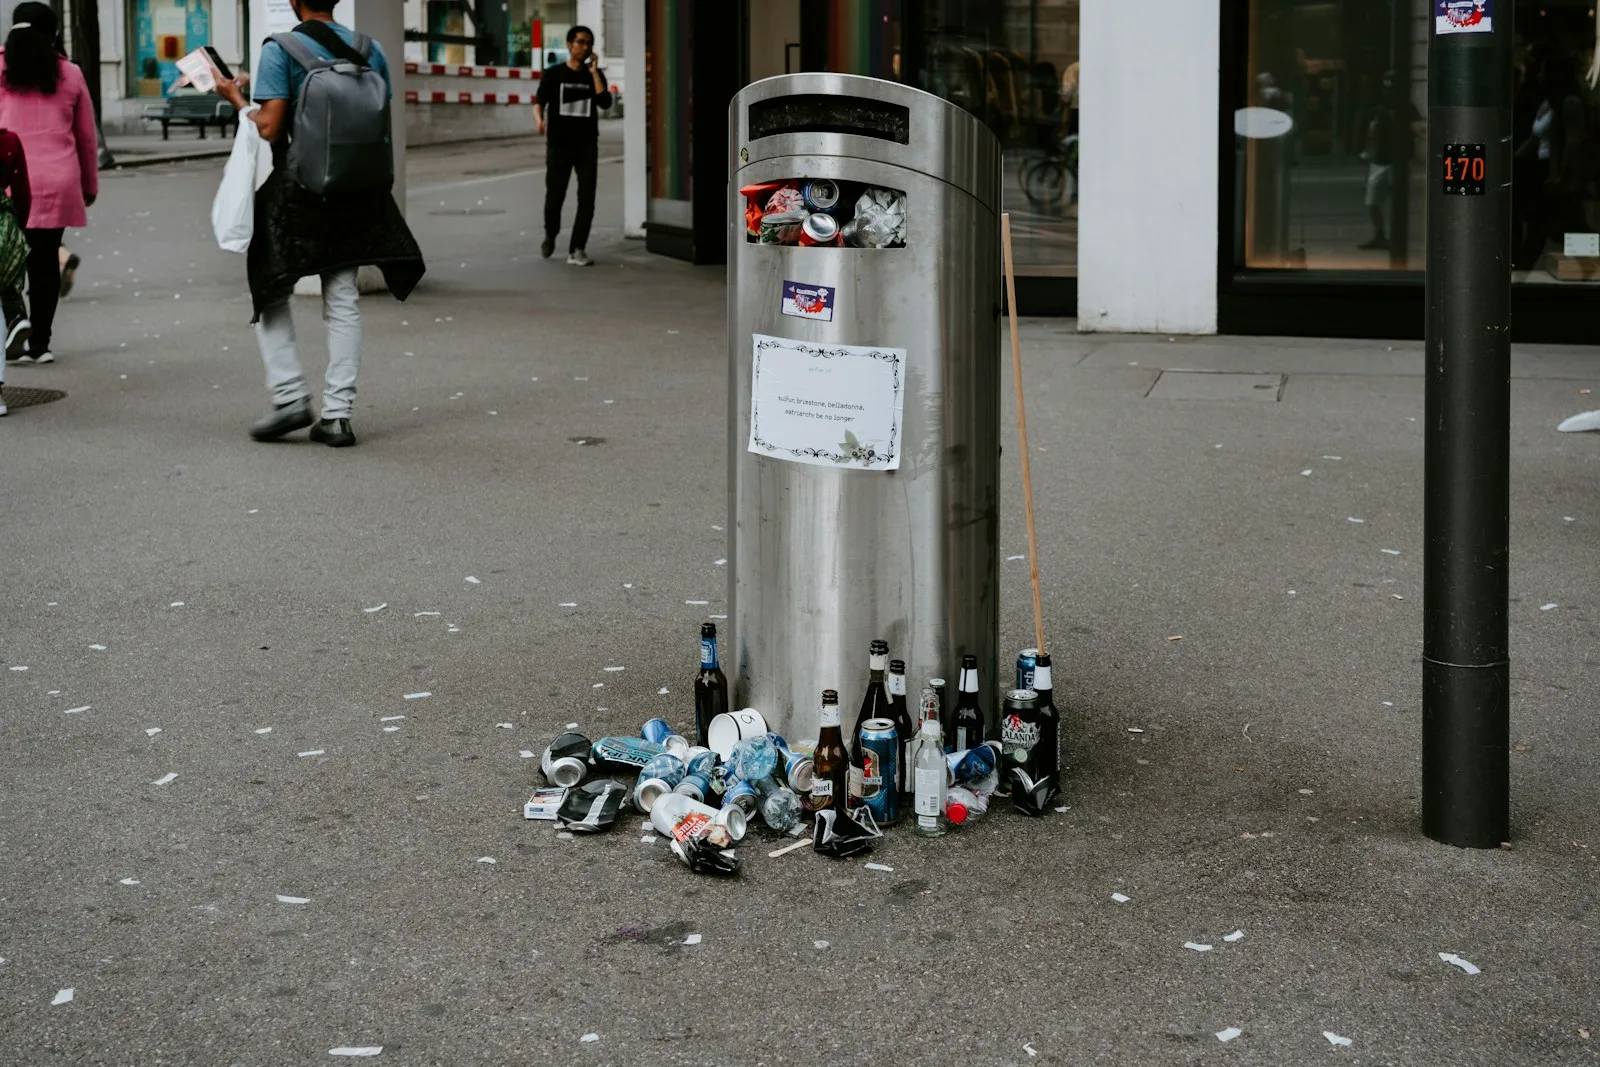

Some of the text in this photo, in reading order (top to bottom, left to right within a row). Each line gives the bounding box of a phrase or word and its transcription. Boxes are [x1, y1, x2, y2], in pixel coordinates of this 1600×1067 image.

[1444, 157, 1485, 181] 170
[828, 401, 865, 411] belladonna,
[785, 409, 815, 418] patriarchy
[816, 412, 823, 420] be
[833, 413, 856, 423] longer
[676, 817, 700, 836] STELLA
